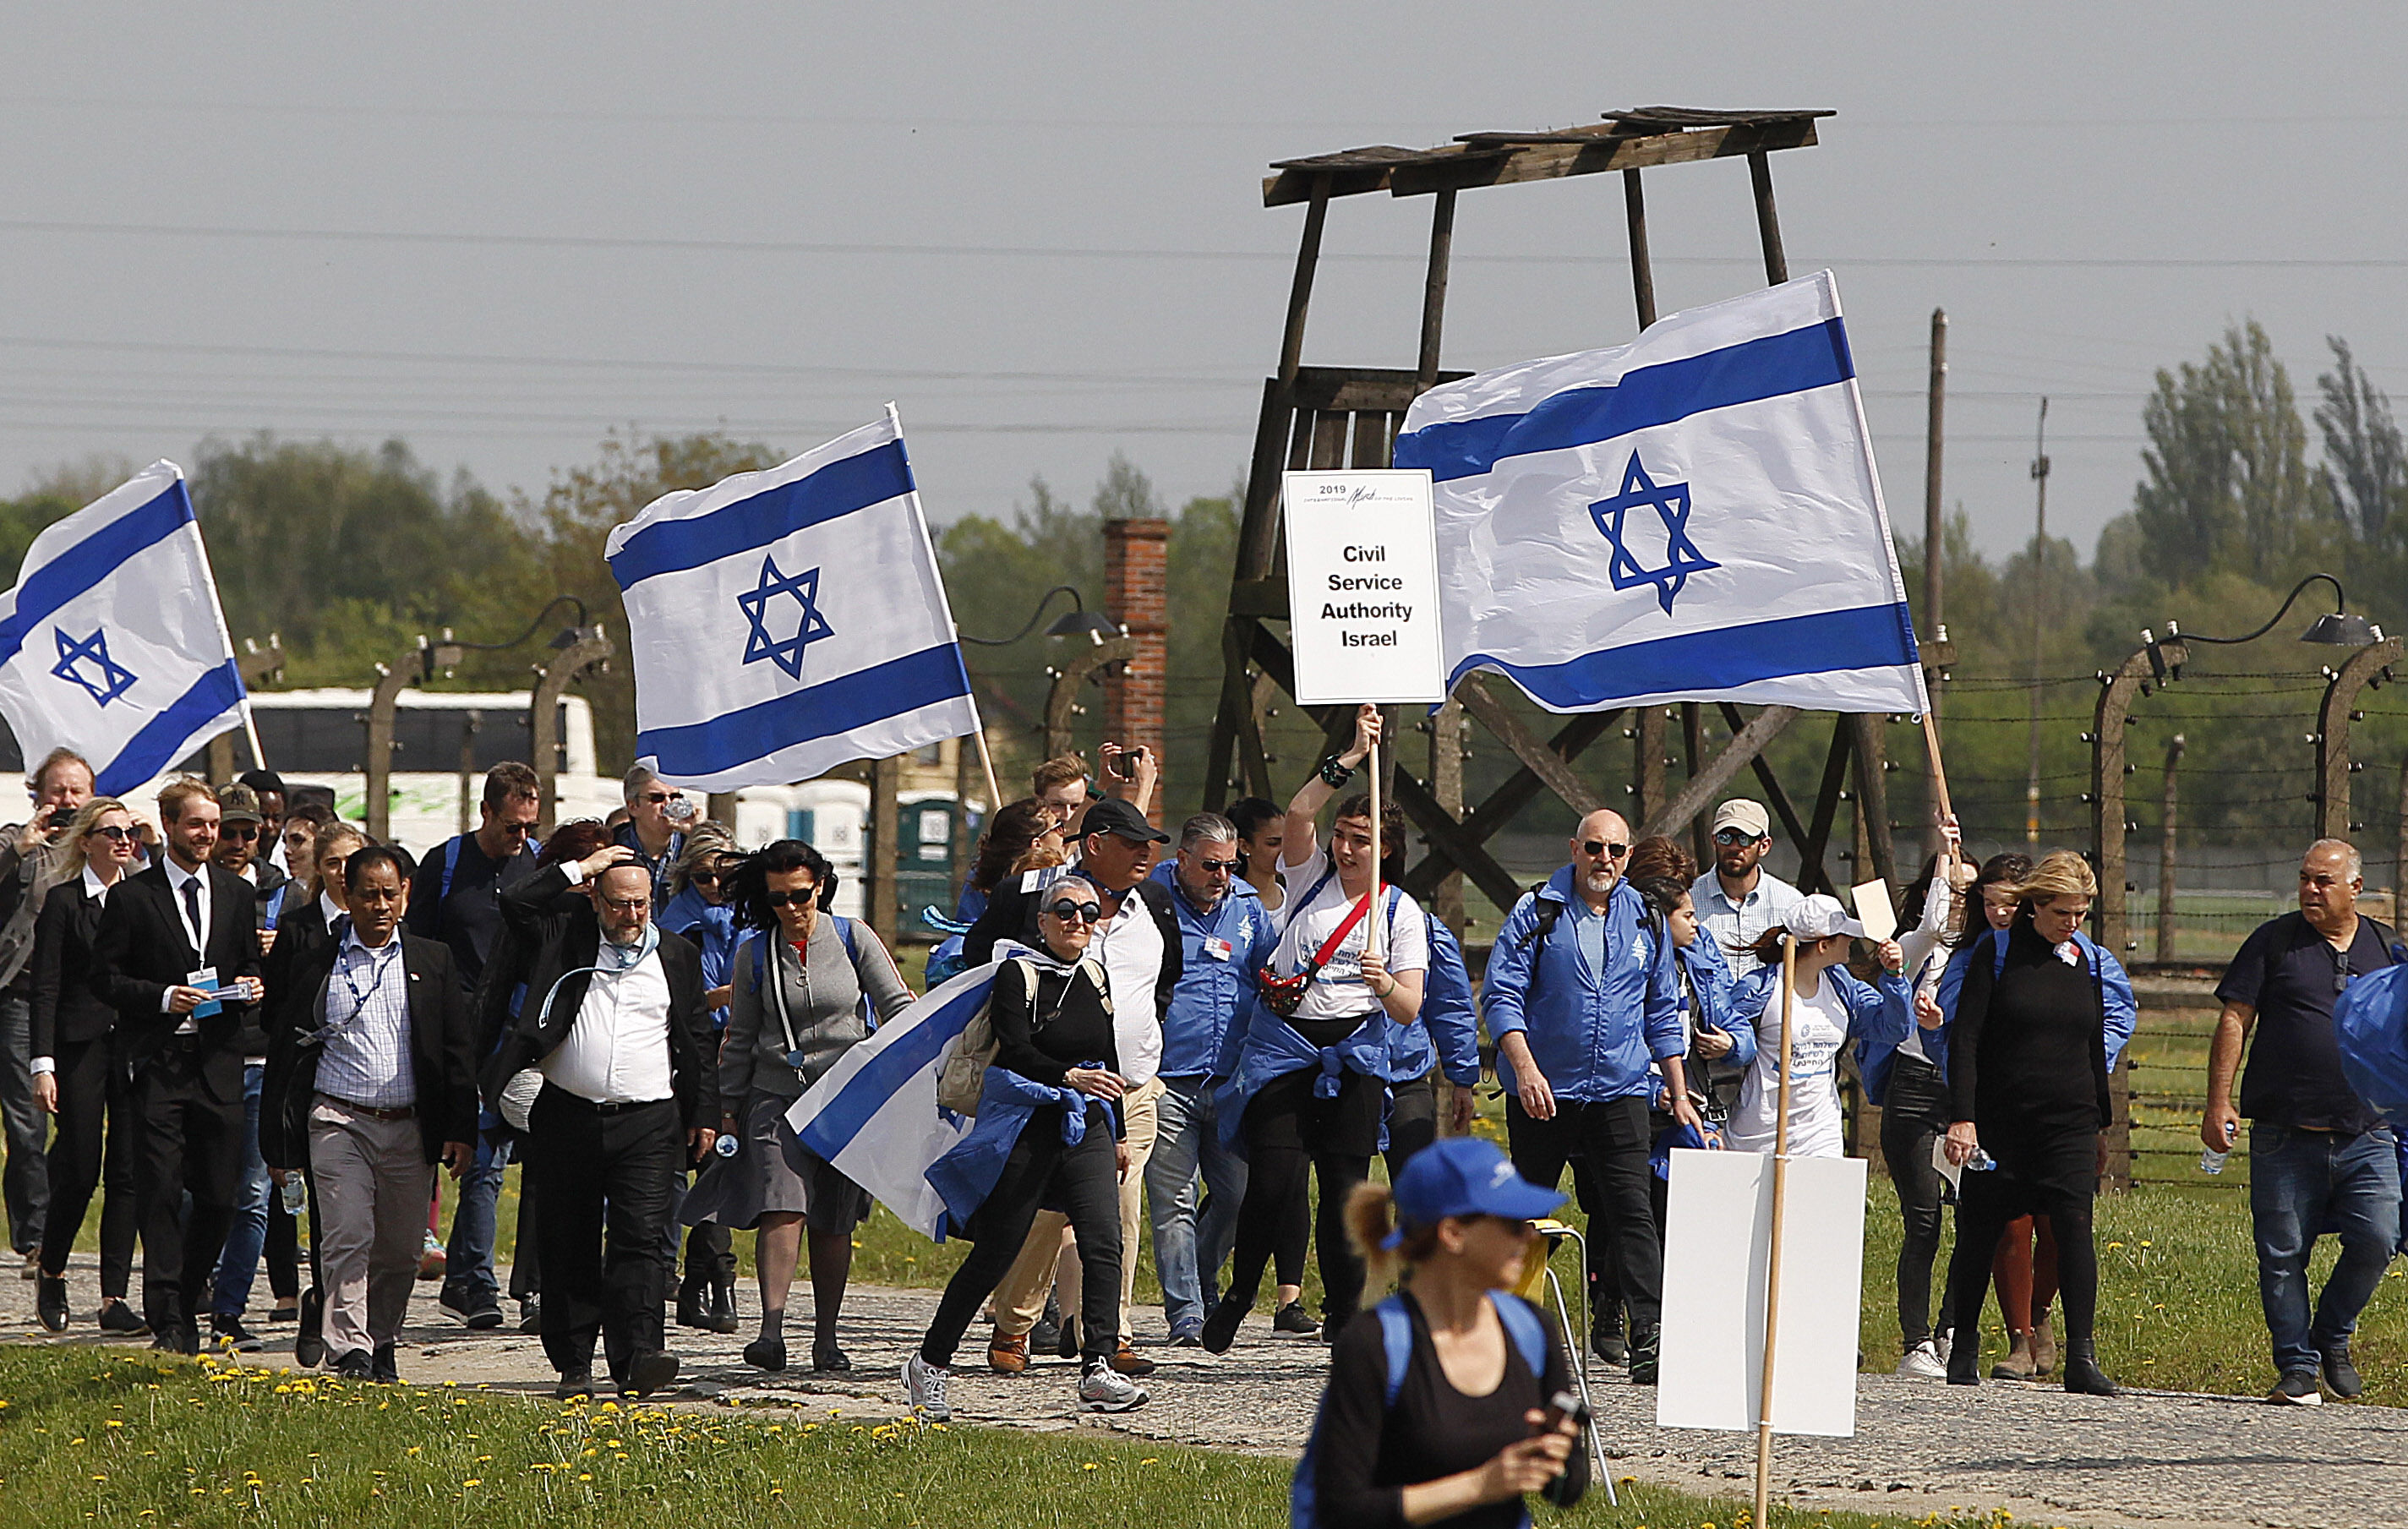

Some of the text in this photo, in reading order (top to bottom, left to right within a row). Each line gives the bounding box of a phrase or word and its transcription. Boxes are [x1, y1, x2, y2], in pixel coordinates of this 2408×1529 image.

[1319, 485, 1346, 494] 2019
[1344, 546, 1384, 562] Civil
[1329, 574, 1402, 590] Service
[1321, 602, 1411, 622] Authority
[1342, 631, 1396, 647] Israel
